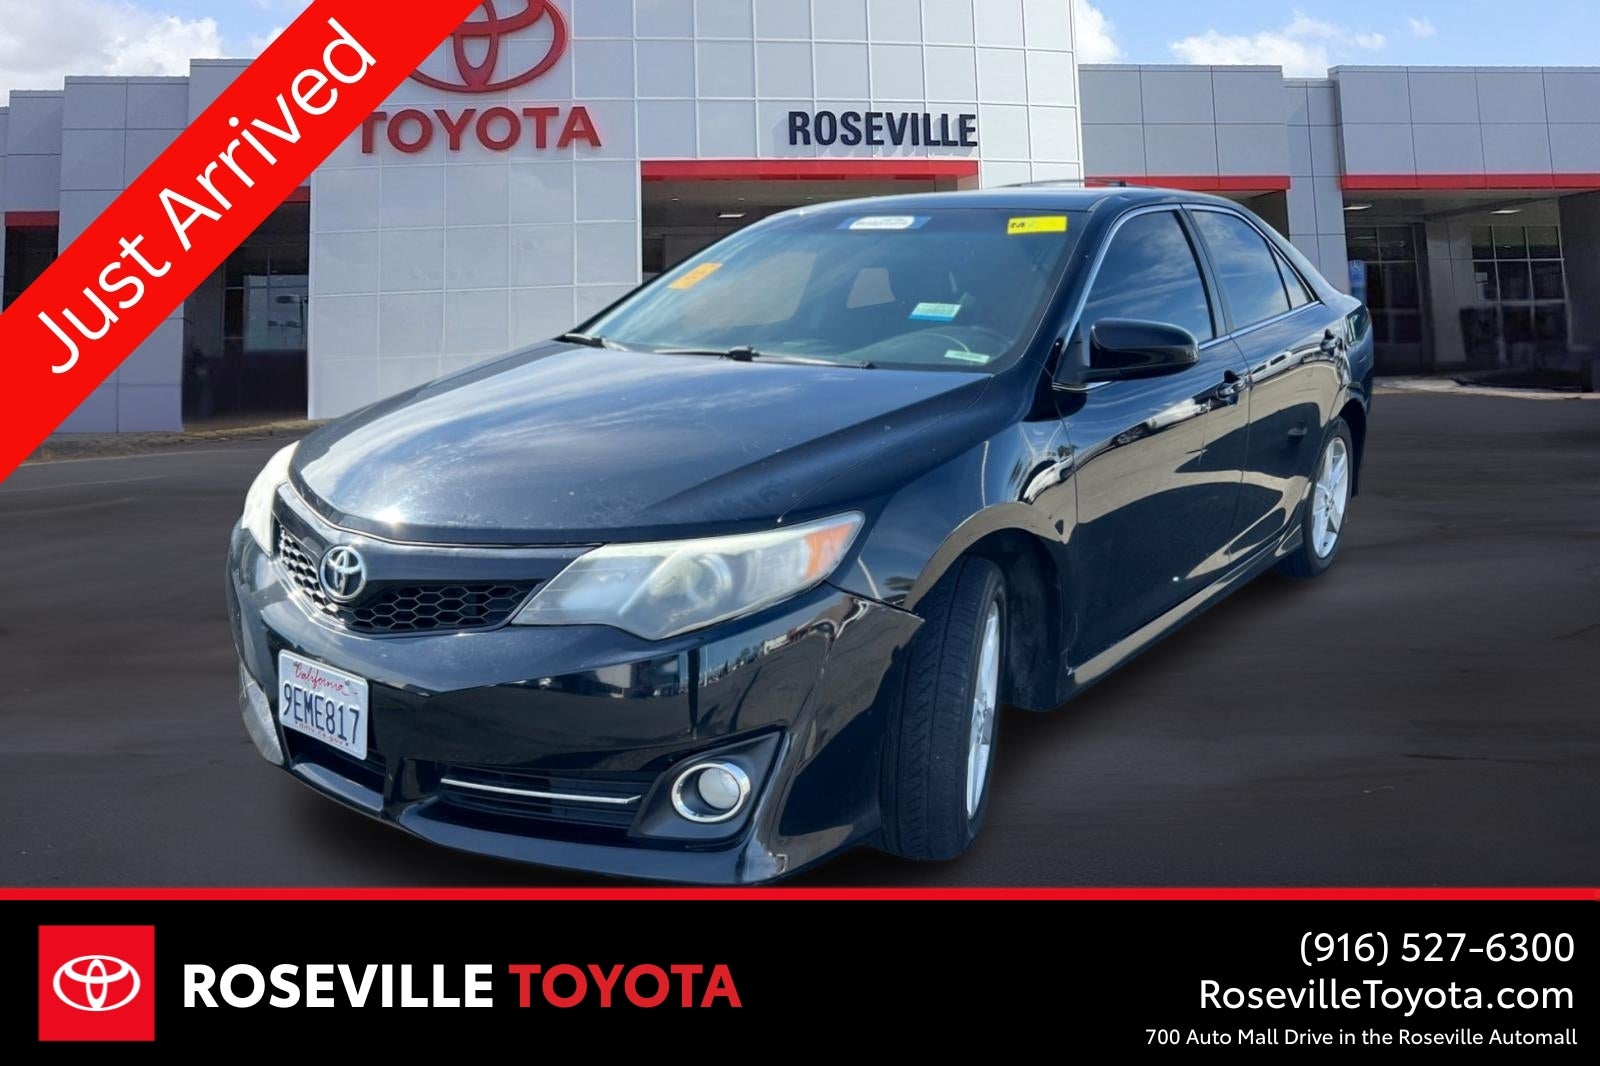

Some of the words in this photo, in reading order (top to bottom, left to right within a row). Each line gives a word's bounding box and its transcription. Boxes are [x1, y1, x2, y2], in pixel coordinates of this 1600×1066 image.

[361, 107, 602, 154] TOYOTA
[788, 110, 978, 147] ROSEVILLE
[294, 661, 350, 696] California
[283, 682, 360, 745] 9EME817
